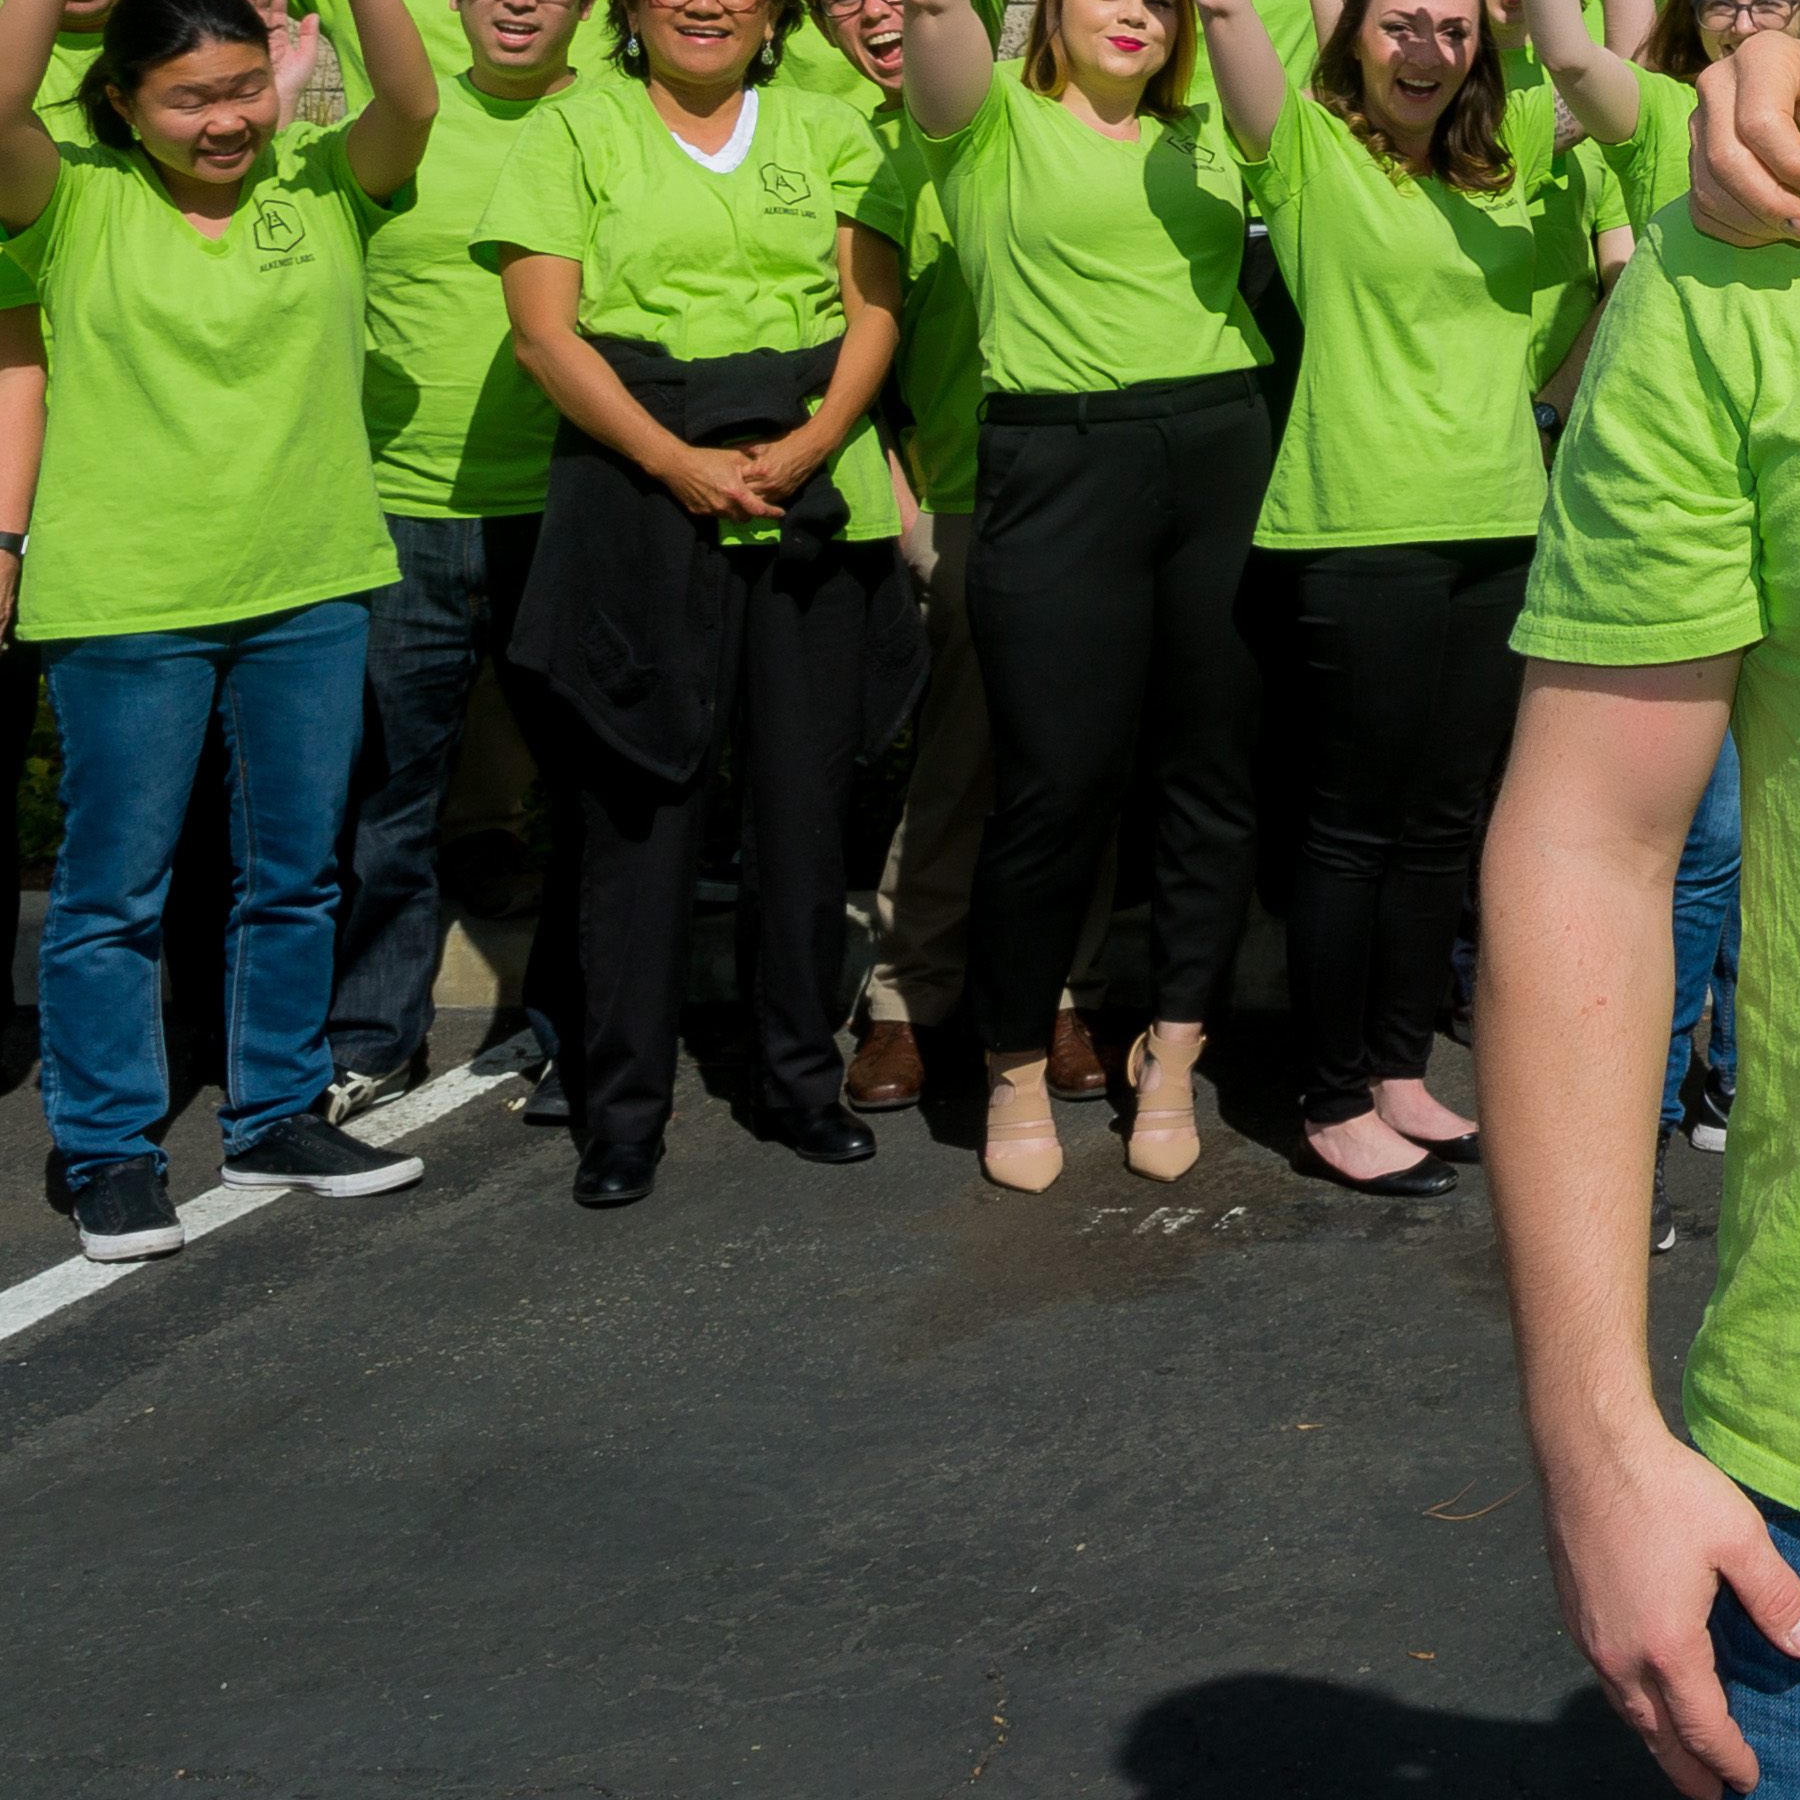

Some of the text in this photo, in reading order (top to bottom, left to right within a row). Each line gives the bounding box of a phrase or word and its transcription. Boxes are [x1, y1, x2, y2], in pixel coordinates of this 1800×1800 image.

[764, 206, 800, 216] ALKEMIST
[260, 253, 316, 273] ALKEMIST LABS
